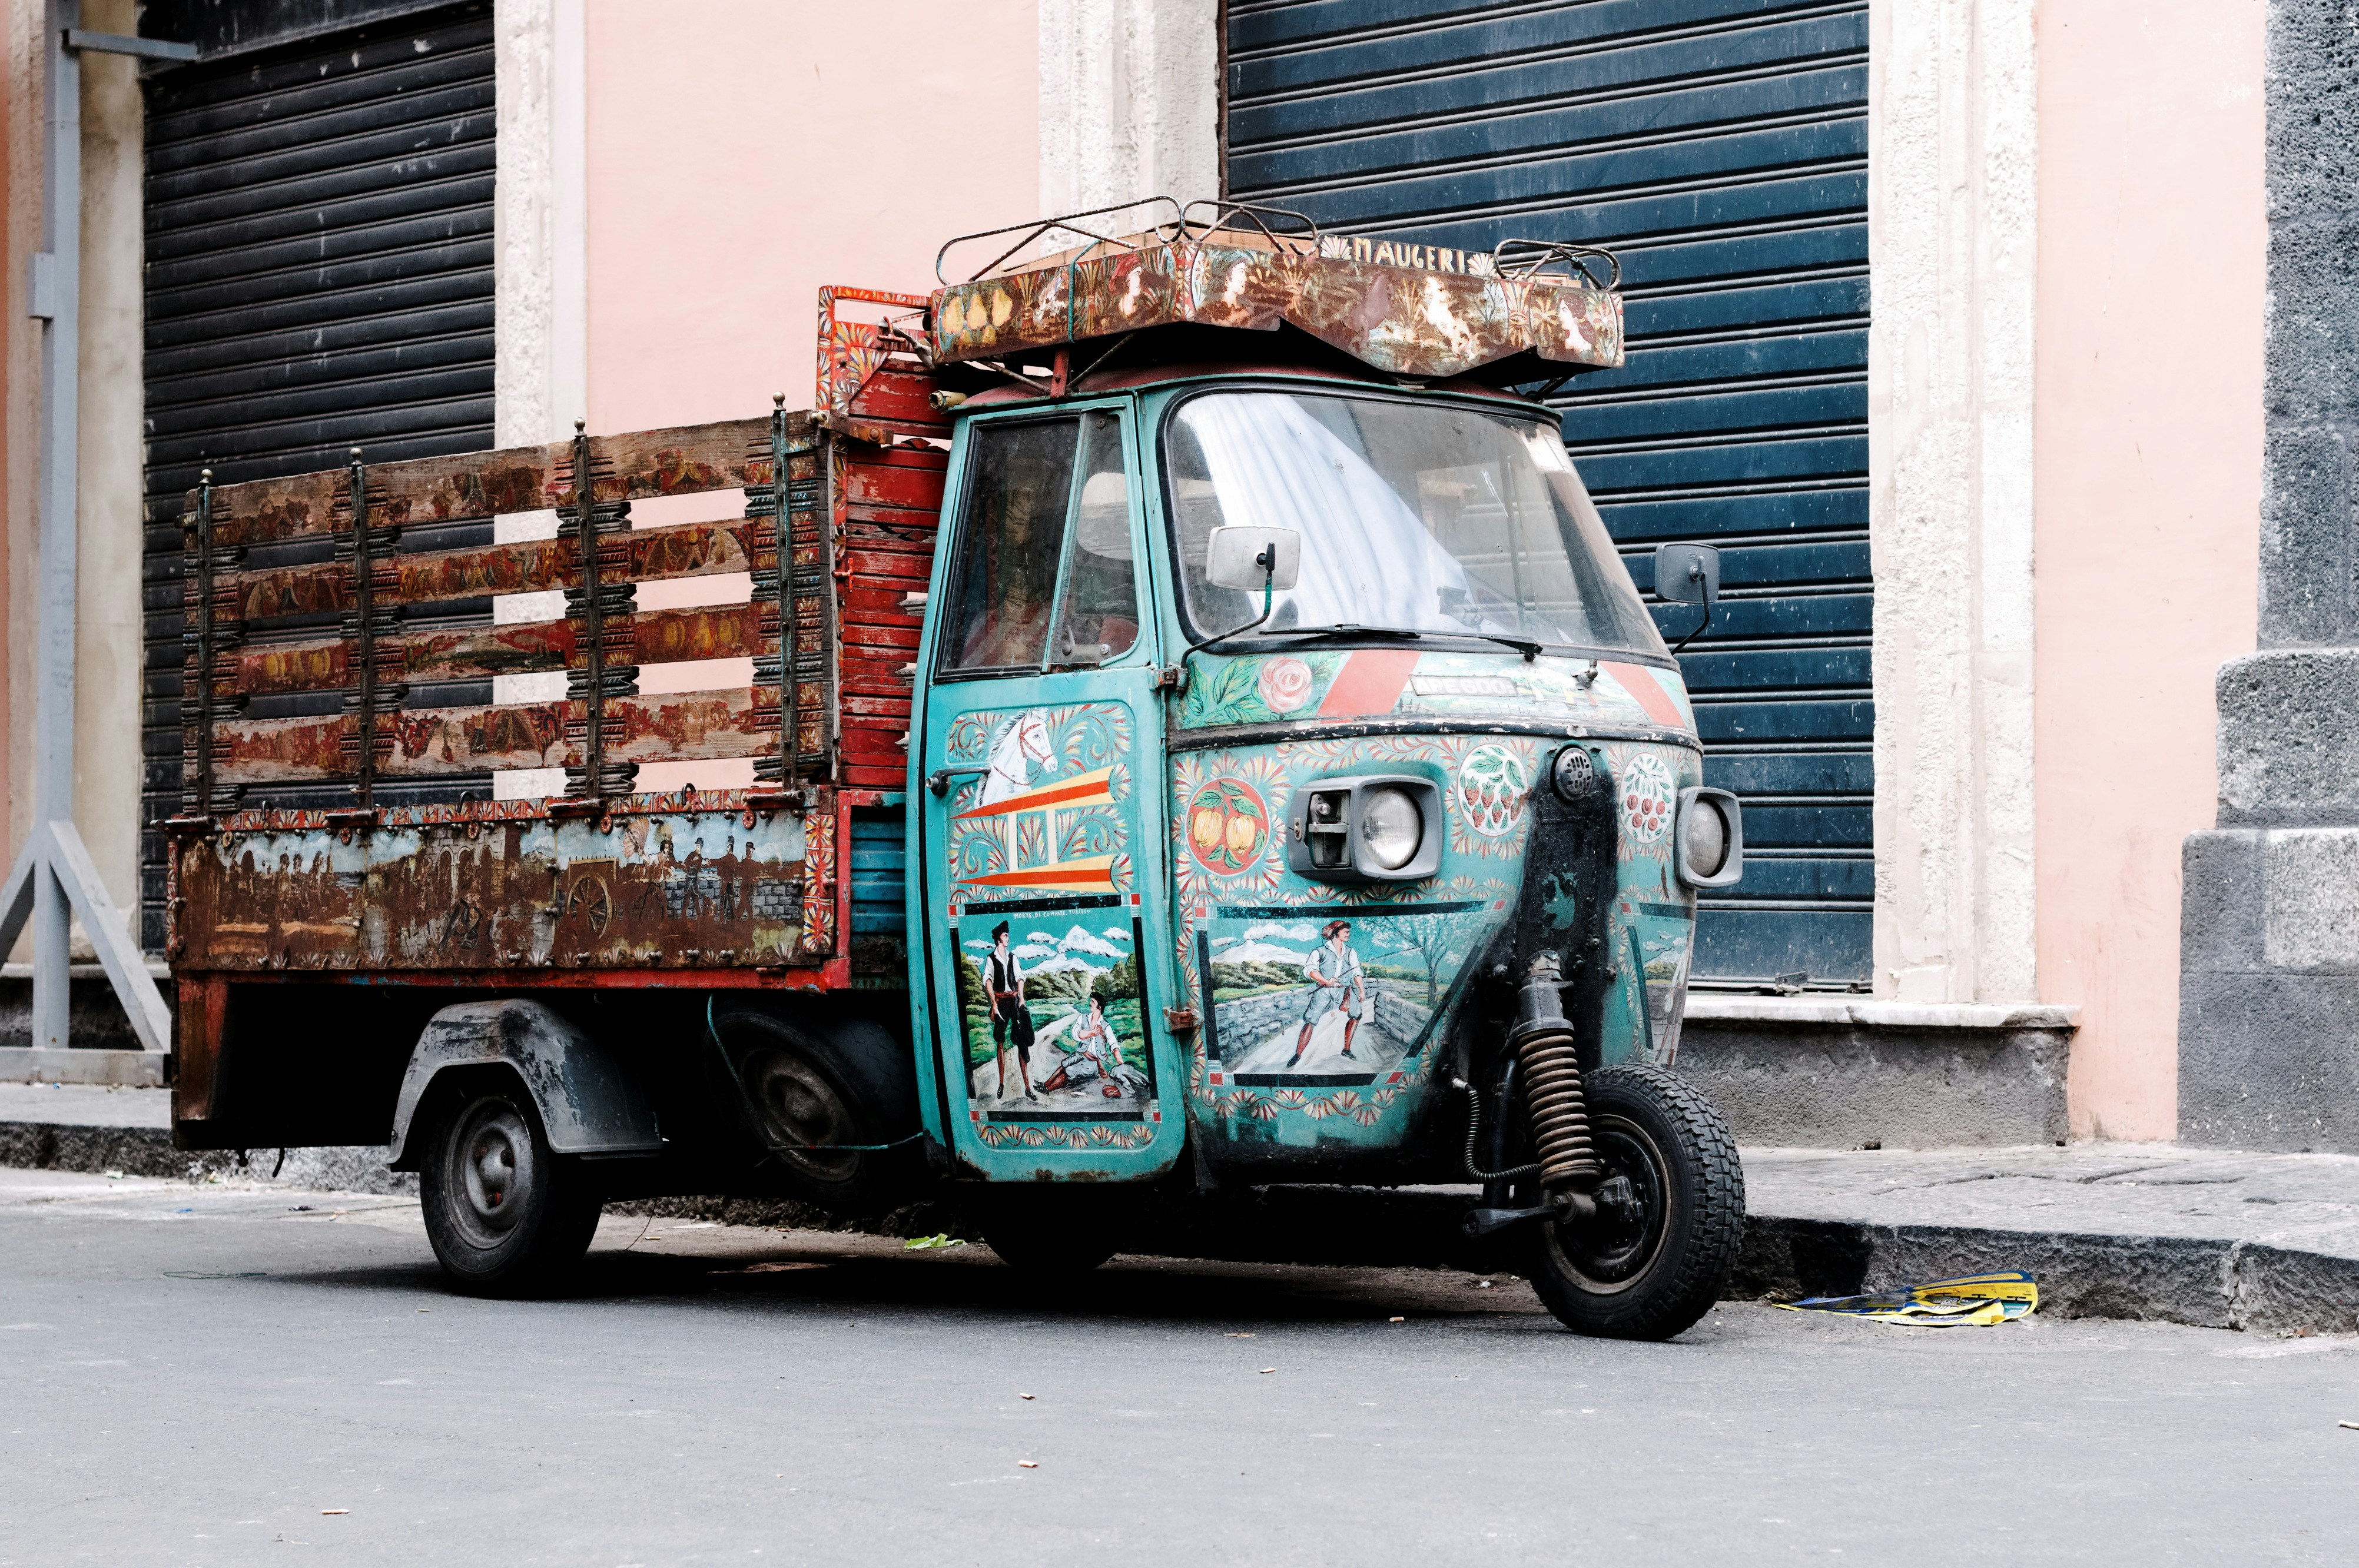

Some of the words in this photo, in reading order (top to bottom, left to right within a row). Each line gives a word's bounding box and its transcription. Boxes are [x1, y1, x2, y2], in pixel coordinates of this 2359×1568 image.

[1354, 237, 1465, 274] MAUGERI
[1415, 678, 1460, 693] APE
[1460, 679, 1507, 694] 600
